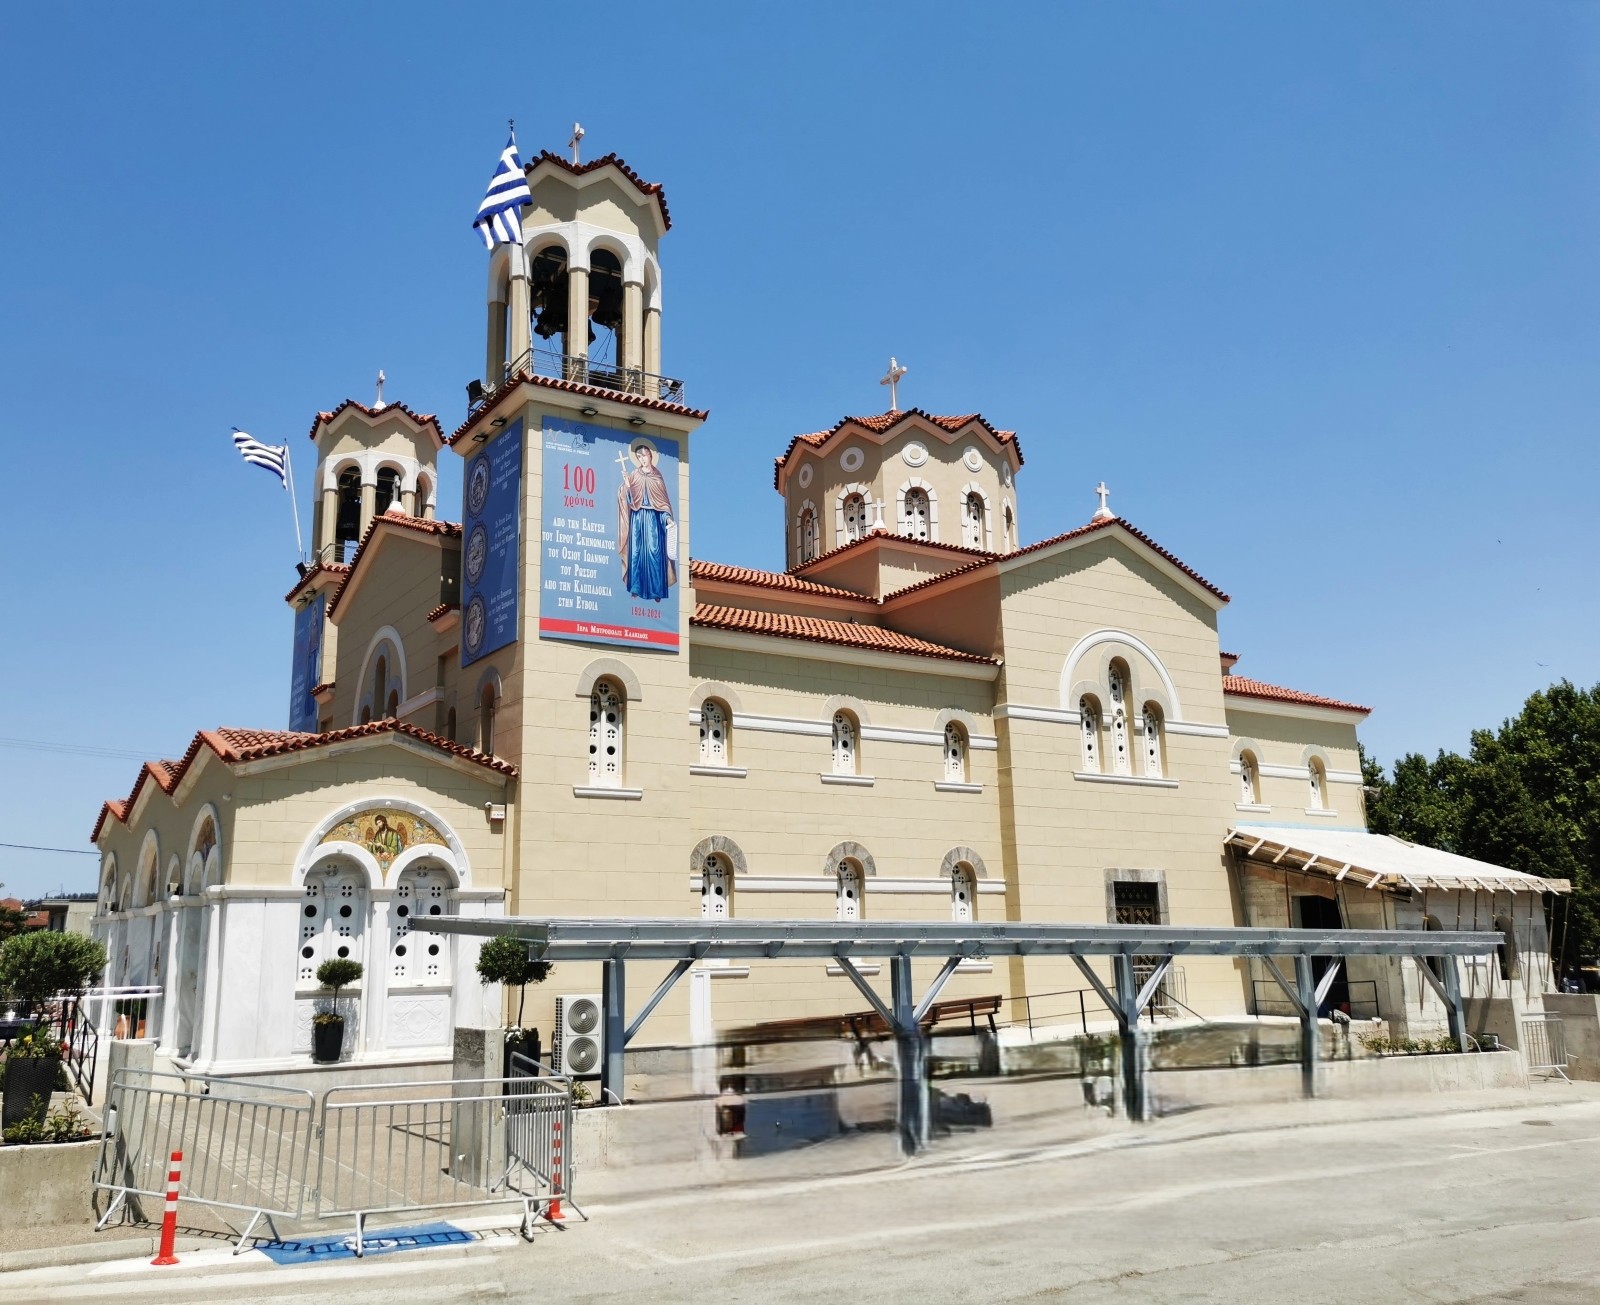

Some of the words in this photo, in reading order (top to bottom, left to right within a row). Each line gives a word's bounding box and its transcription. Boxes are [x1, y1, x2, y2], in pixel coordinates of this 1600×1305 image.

[563, 463, 595, 494] 100
[564, 493, 594, 508] χρόνια
[553, 517, 565, 527] ΑΠΟ
[568, 519, 580, 529] ΤΗΝ
[582, 518, 605, 533] ΕΛΕΥΣΗ
[542, 531, 553, 541] ΤΟΥ
[556, 530, 573, 544] ΙΕΡΟΥ
[576, 533, 615, 550] ΣΚΗΝΩΜΑΤΟΣ
[548, 548, 559, 558] ΤΟΥ
[562, 546, 581, 561] ΟΣΙΟΥ
[584, 549, 609, 564] ΙΩΑΝΝΟΥ
[561, 566, 571, 575] ΤΟΥ
[574, 564, 597, 578] ΡΩΣΣΟΥ
[544, 580, 556, 590] ΑΠΟ
[559, 582, 571, 591] ΤΗΝ
[574, 580, 612, 596] ΚΑΠΠΑΔΟΚΙΑ
[558, 597, 573, 608] ΣΤΗΝ
[576, 596, 598, 611] ΕΥΒΟΙΑ
[631, 606, 661, 619] 1924-2024
[577, 624, 588, 632] ΙΕΡΑ
[591, 625, 622, 636] ΜΗΤΡΟΠΟΛΙΣ
[624, 629, 648, 639] ΧΑΛΚΙΔΟΣ
